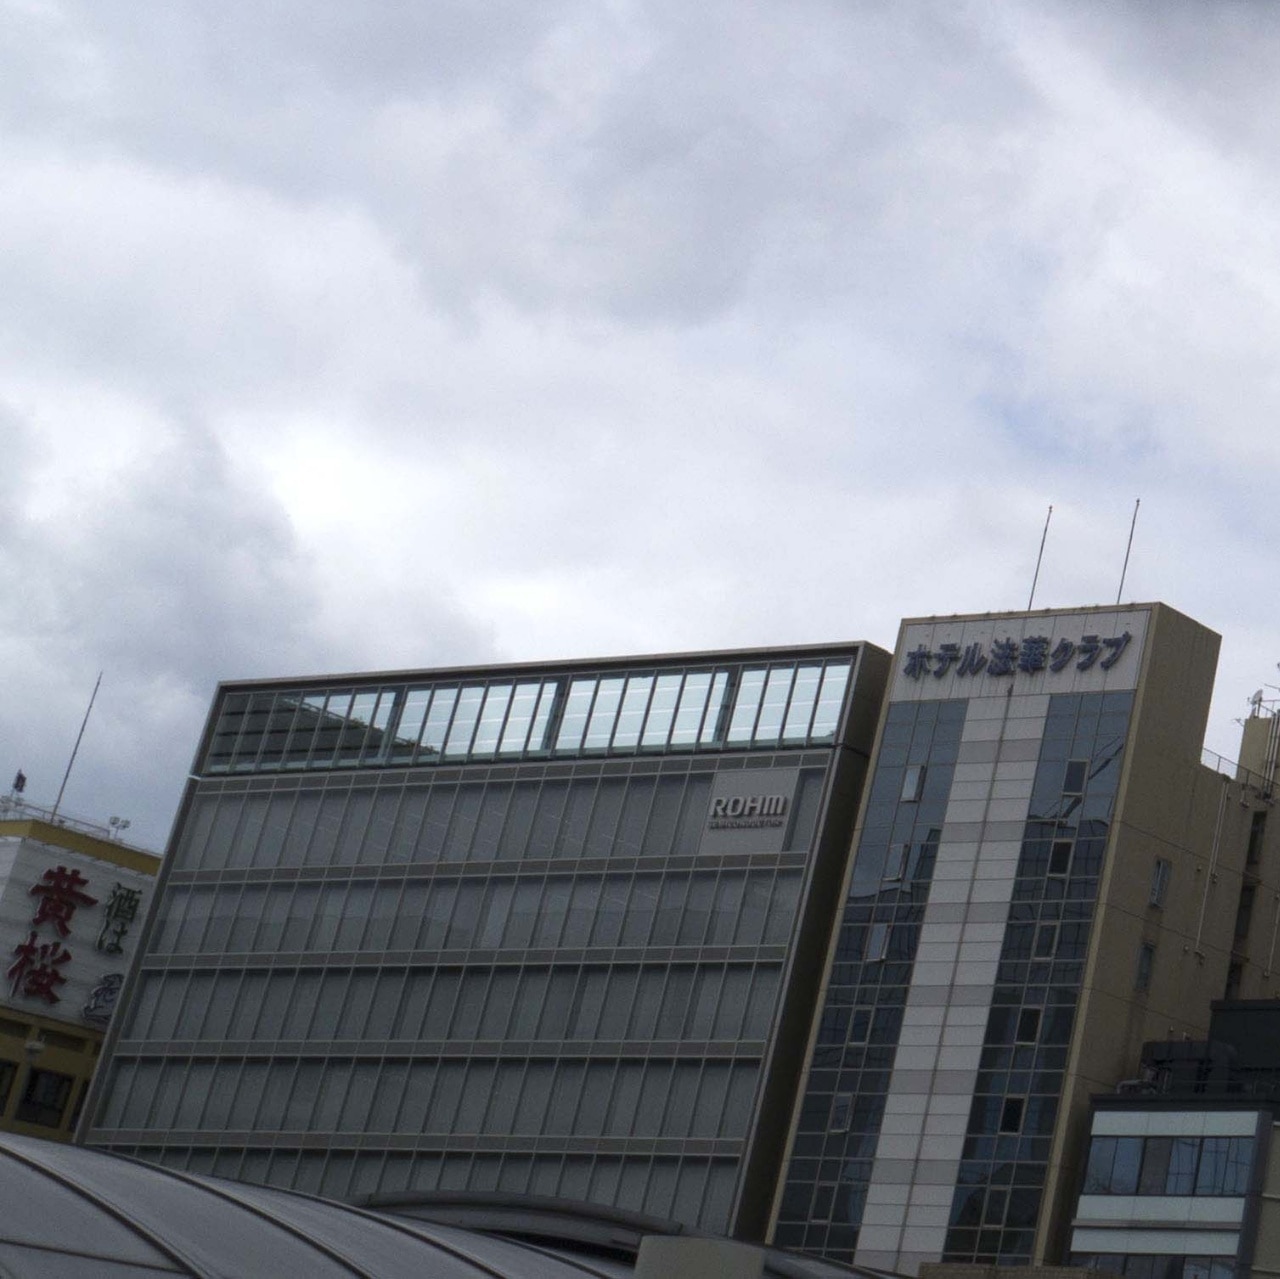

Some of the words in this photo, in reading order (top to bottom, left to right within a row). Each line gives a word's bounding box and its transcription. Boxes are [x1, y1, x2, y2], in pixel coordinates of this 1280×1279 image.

[904, 631, 1132, 679] ホテル法華クラブ
[709, 796, 786, 817] ROHM
